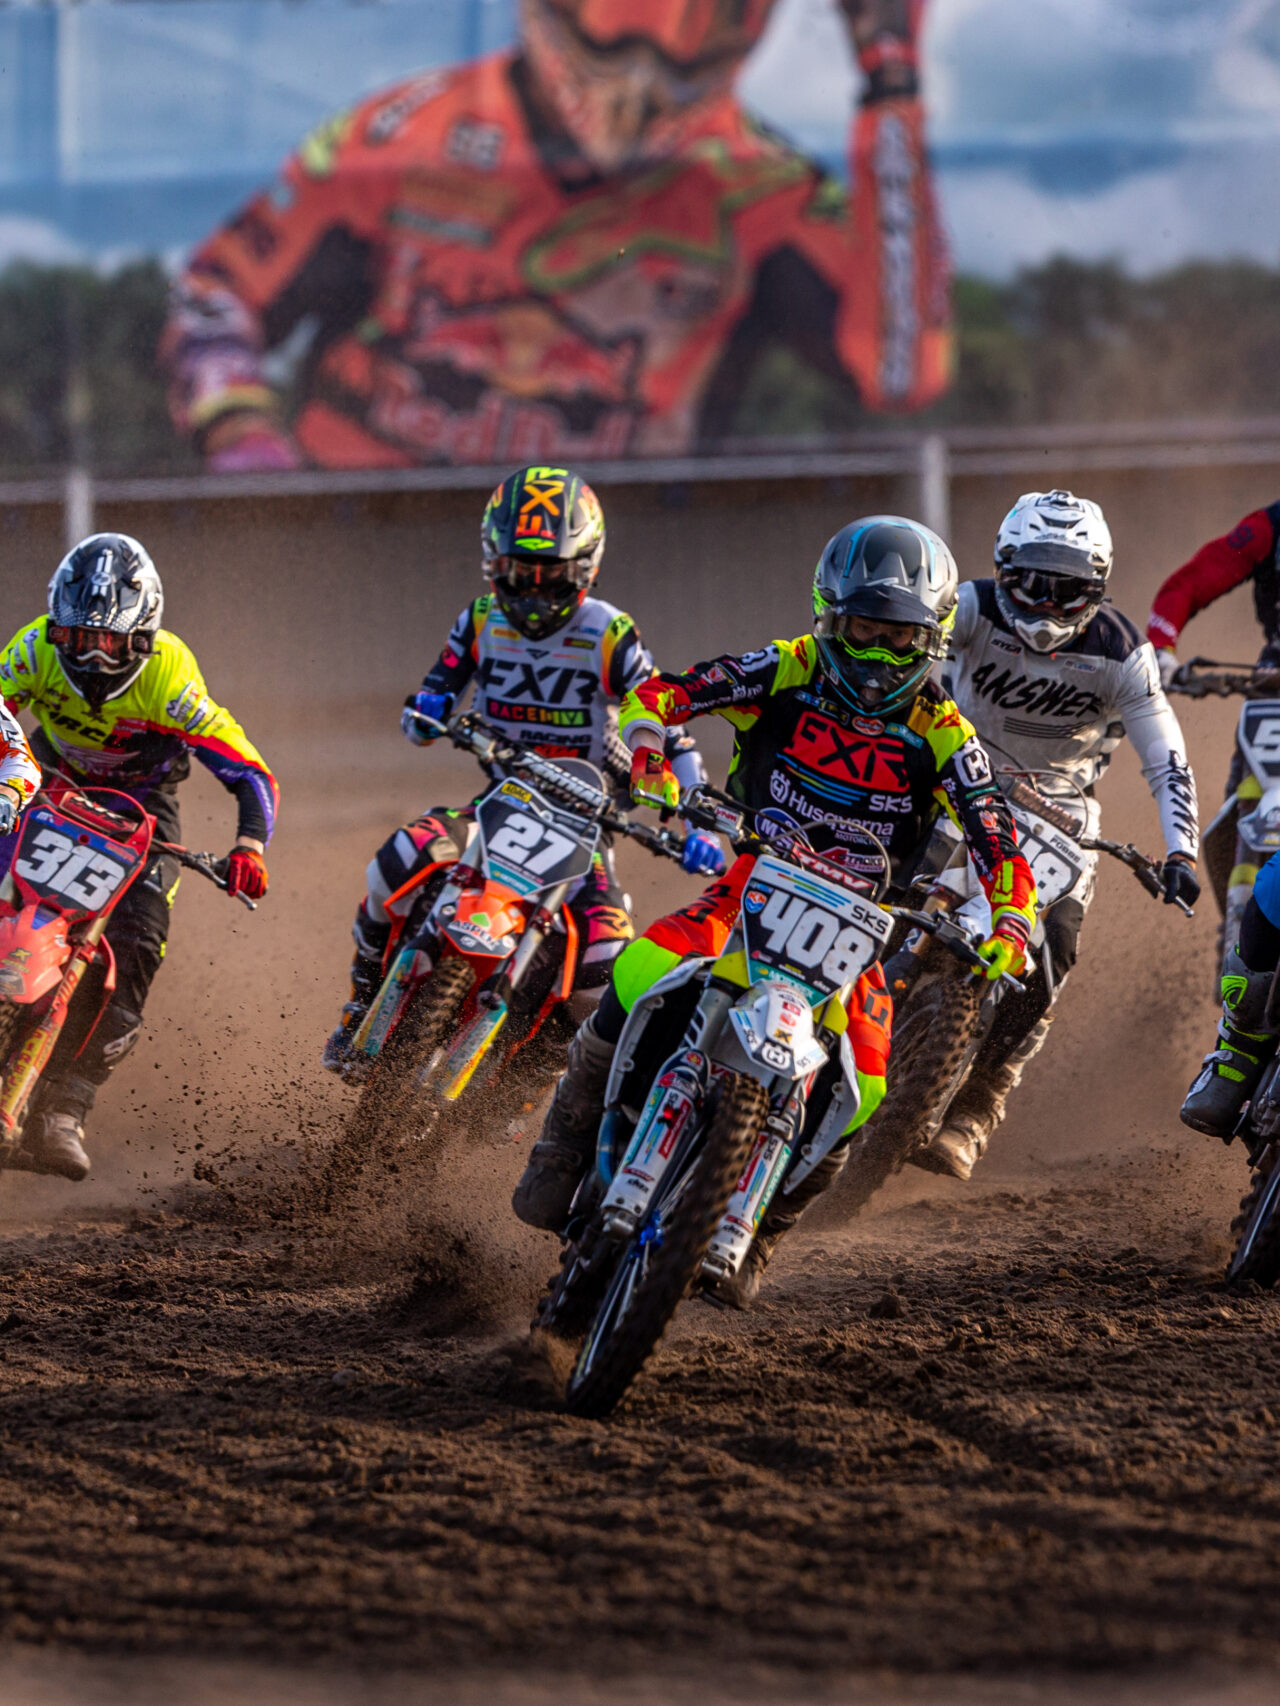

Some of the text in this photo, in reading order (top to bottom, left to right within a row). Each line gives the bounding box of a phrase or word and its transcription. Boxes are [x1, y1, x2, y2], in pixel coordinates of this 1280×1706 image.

[479, 656, 599, 705] FXR
[783, 711, 910, 793] FXR
[787, 791, 894, 837] Husqvarna
[868, 794, 913, 814] SKS
[15, 828, 126, 912] 313
[487, 812, 578, 876] 27
[759, 888, 876, 988] 408
[851, 904, 889, 936] SKS
